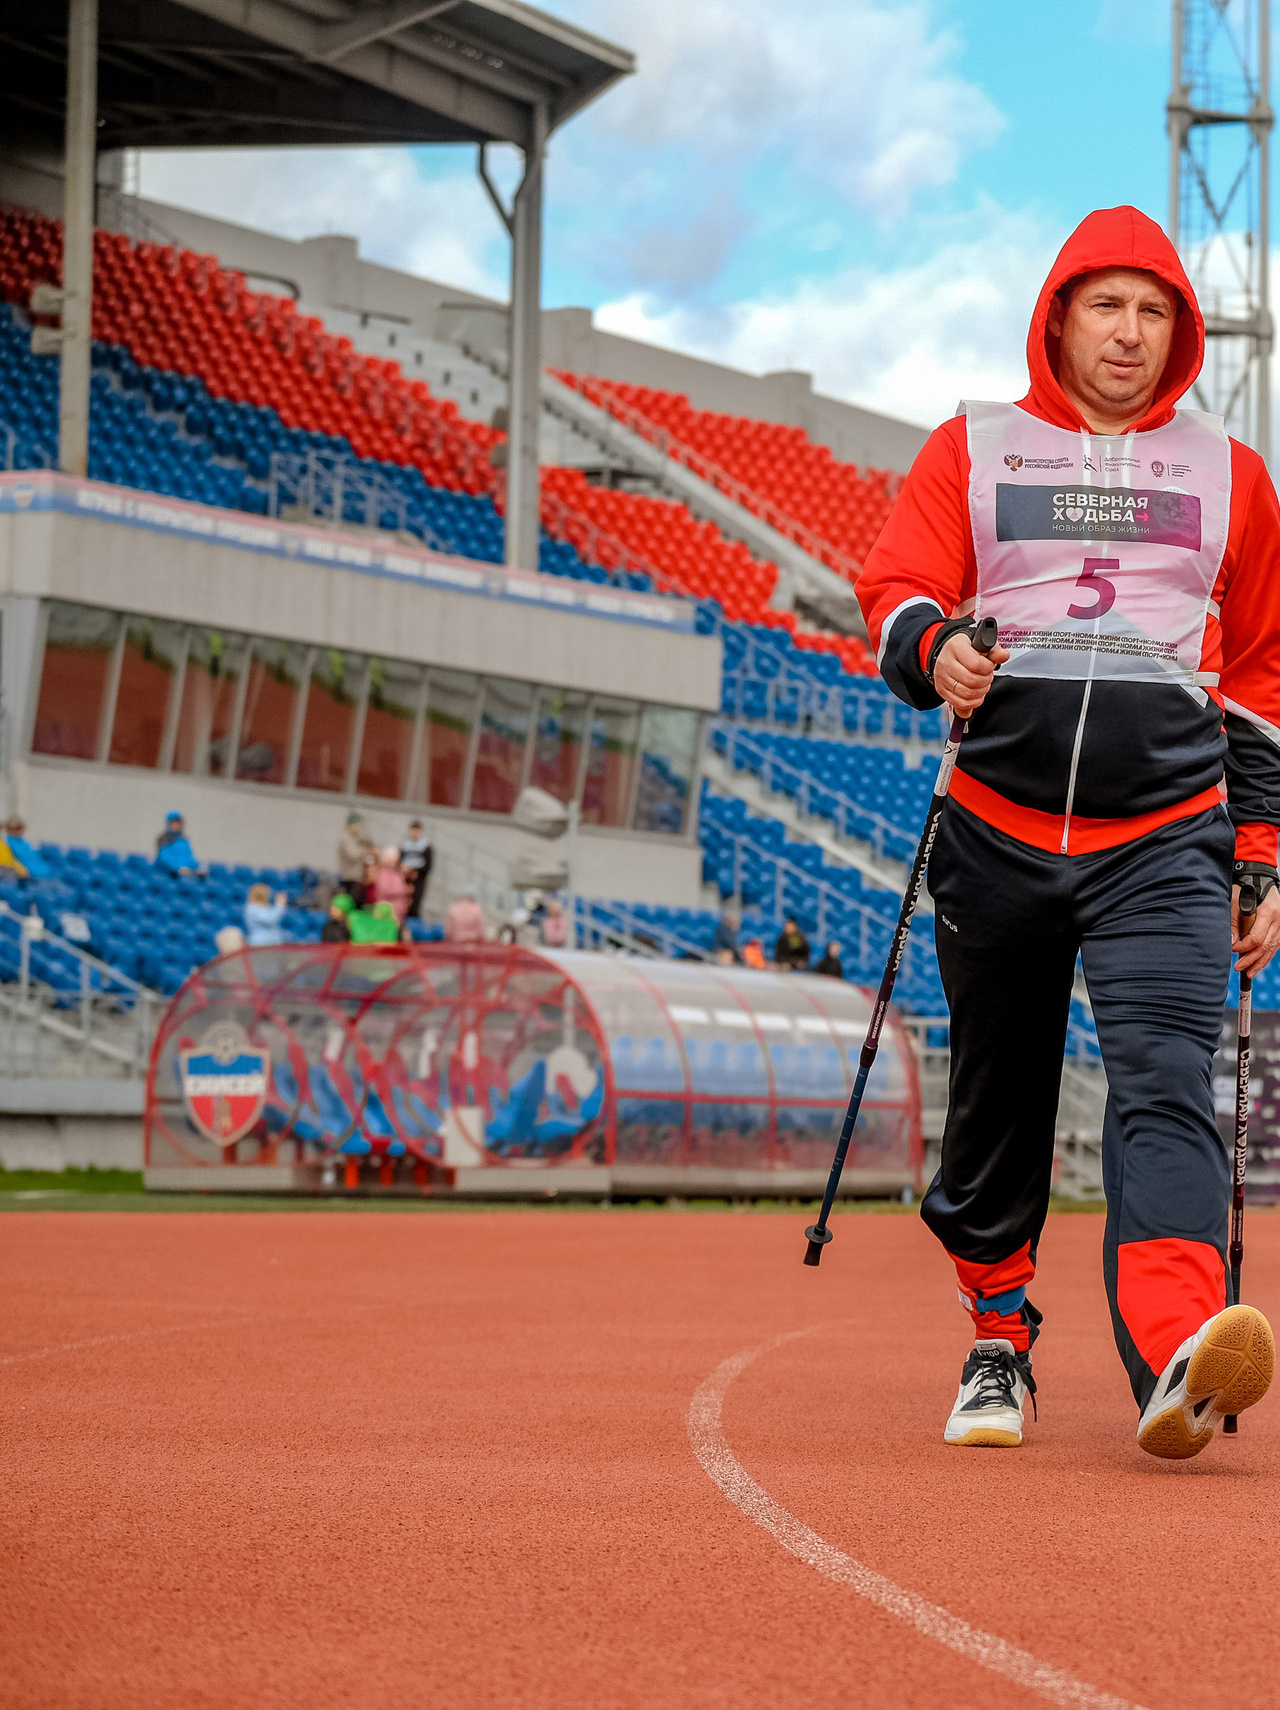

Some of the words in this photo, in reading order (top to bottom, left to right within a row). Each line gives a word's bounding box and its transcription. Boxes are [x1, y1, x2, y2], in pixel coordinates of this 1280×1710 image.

[1052, 493, 1149, 509] СЕВЕРНАЯ
[1052, 524, 1085, 532] НОВЫЙ
[1087, 525, 1116, 533] ОБРАЗ
[1118, 526, 1150, 534] ЖИЗНИ
[1067, 558, 1120, 620] 5
